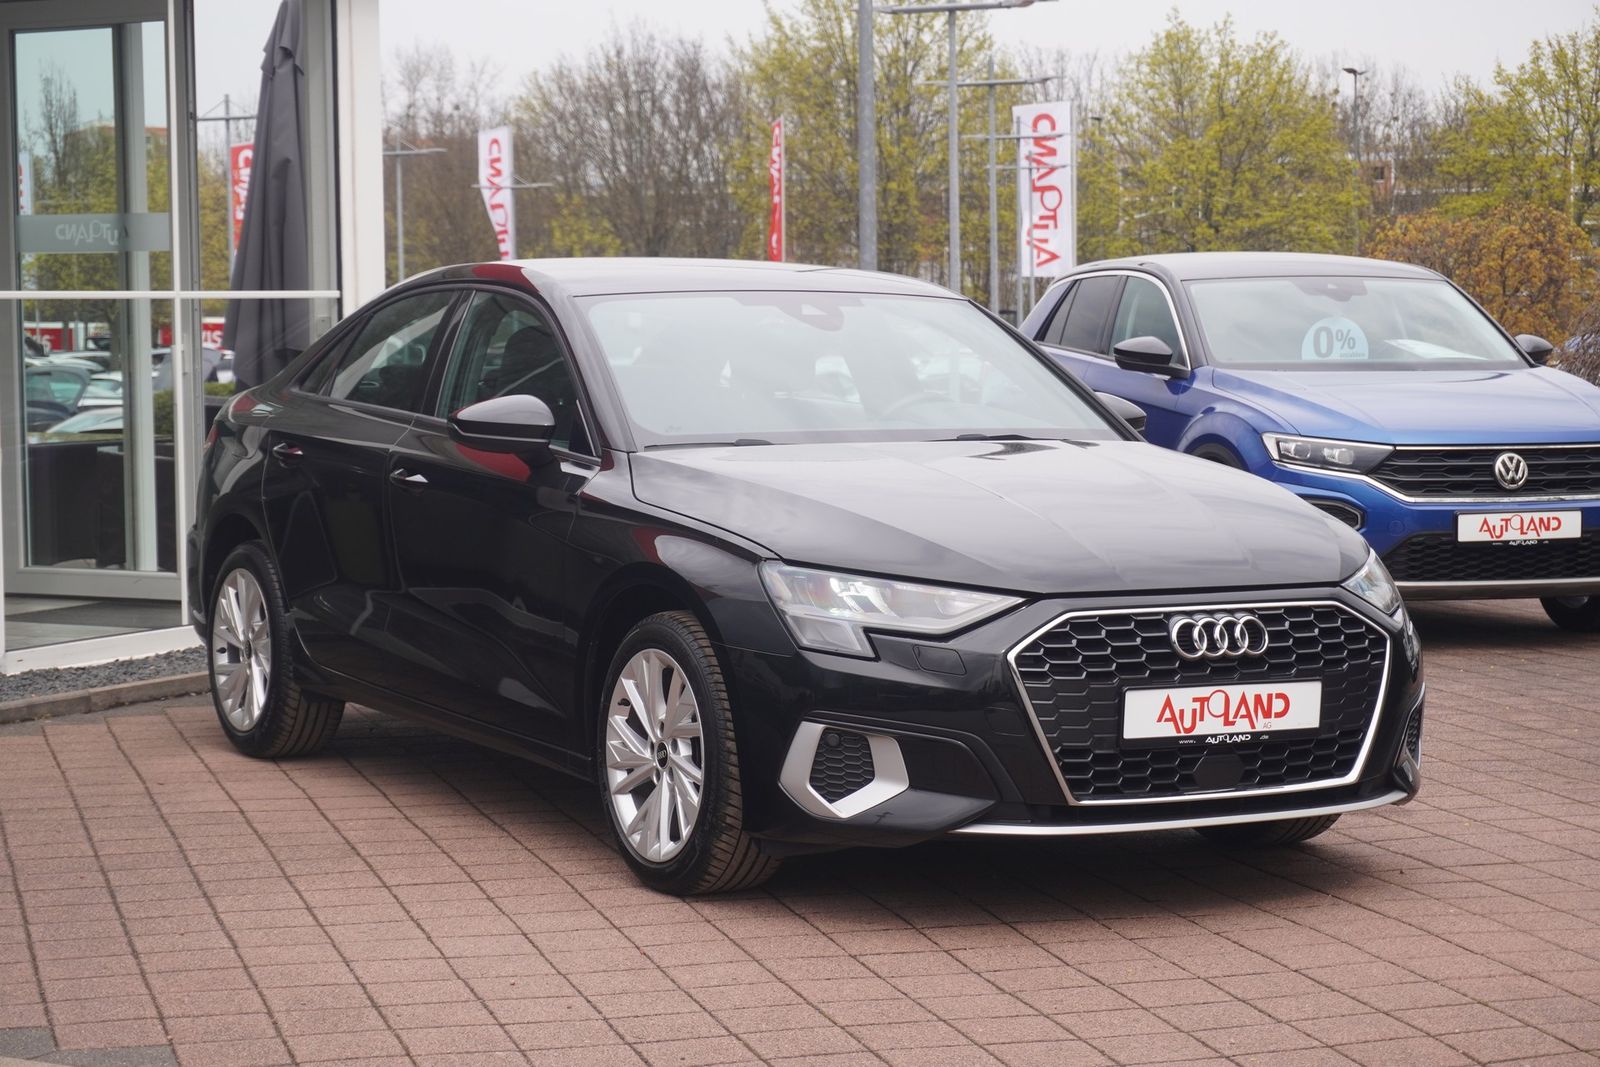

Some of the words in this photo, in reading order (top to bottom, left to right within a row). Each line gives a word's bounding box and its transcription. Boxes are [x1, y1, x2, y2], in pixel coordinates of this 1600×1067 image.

[1313, 326, 1356, 359] 0%
[1479, 514, 1562, 539] AUTOLAND
[1156, 689, 1291, 734] AUTOLAND
[1262, 721, 1272, 729] AG
[1205, 734, 1251, 744] AUTOLAND
